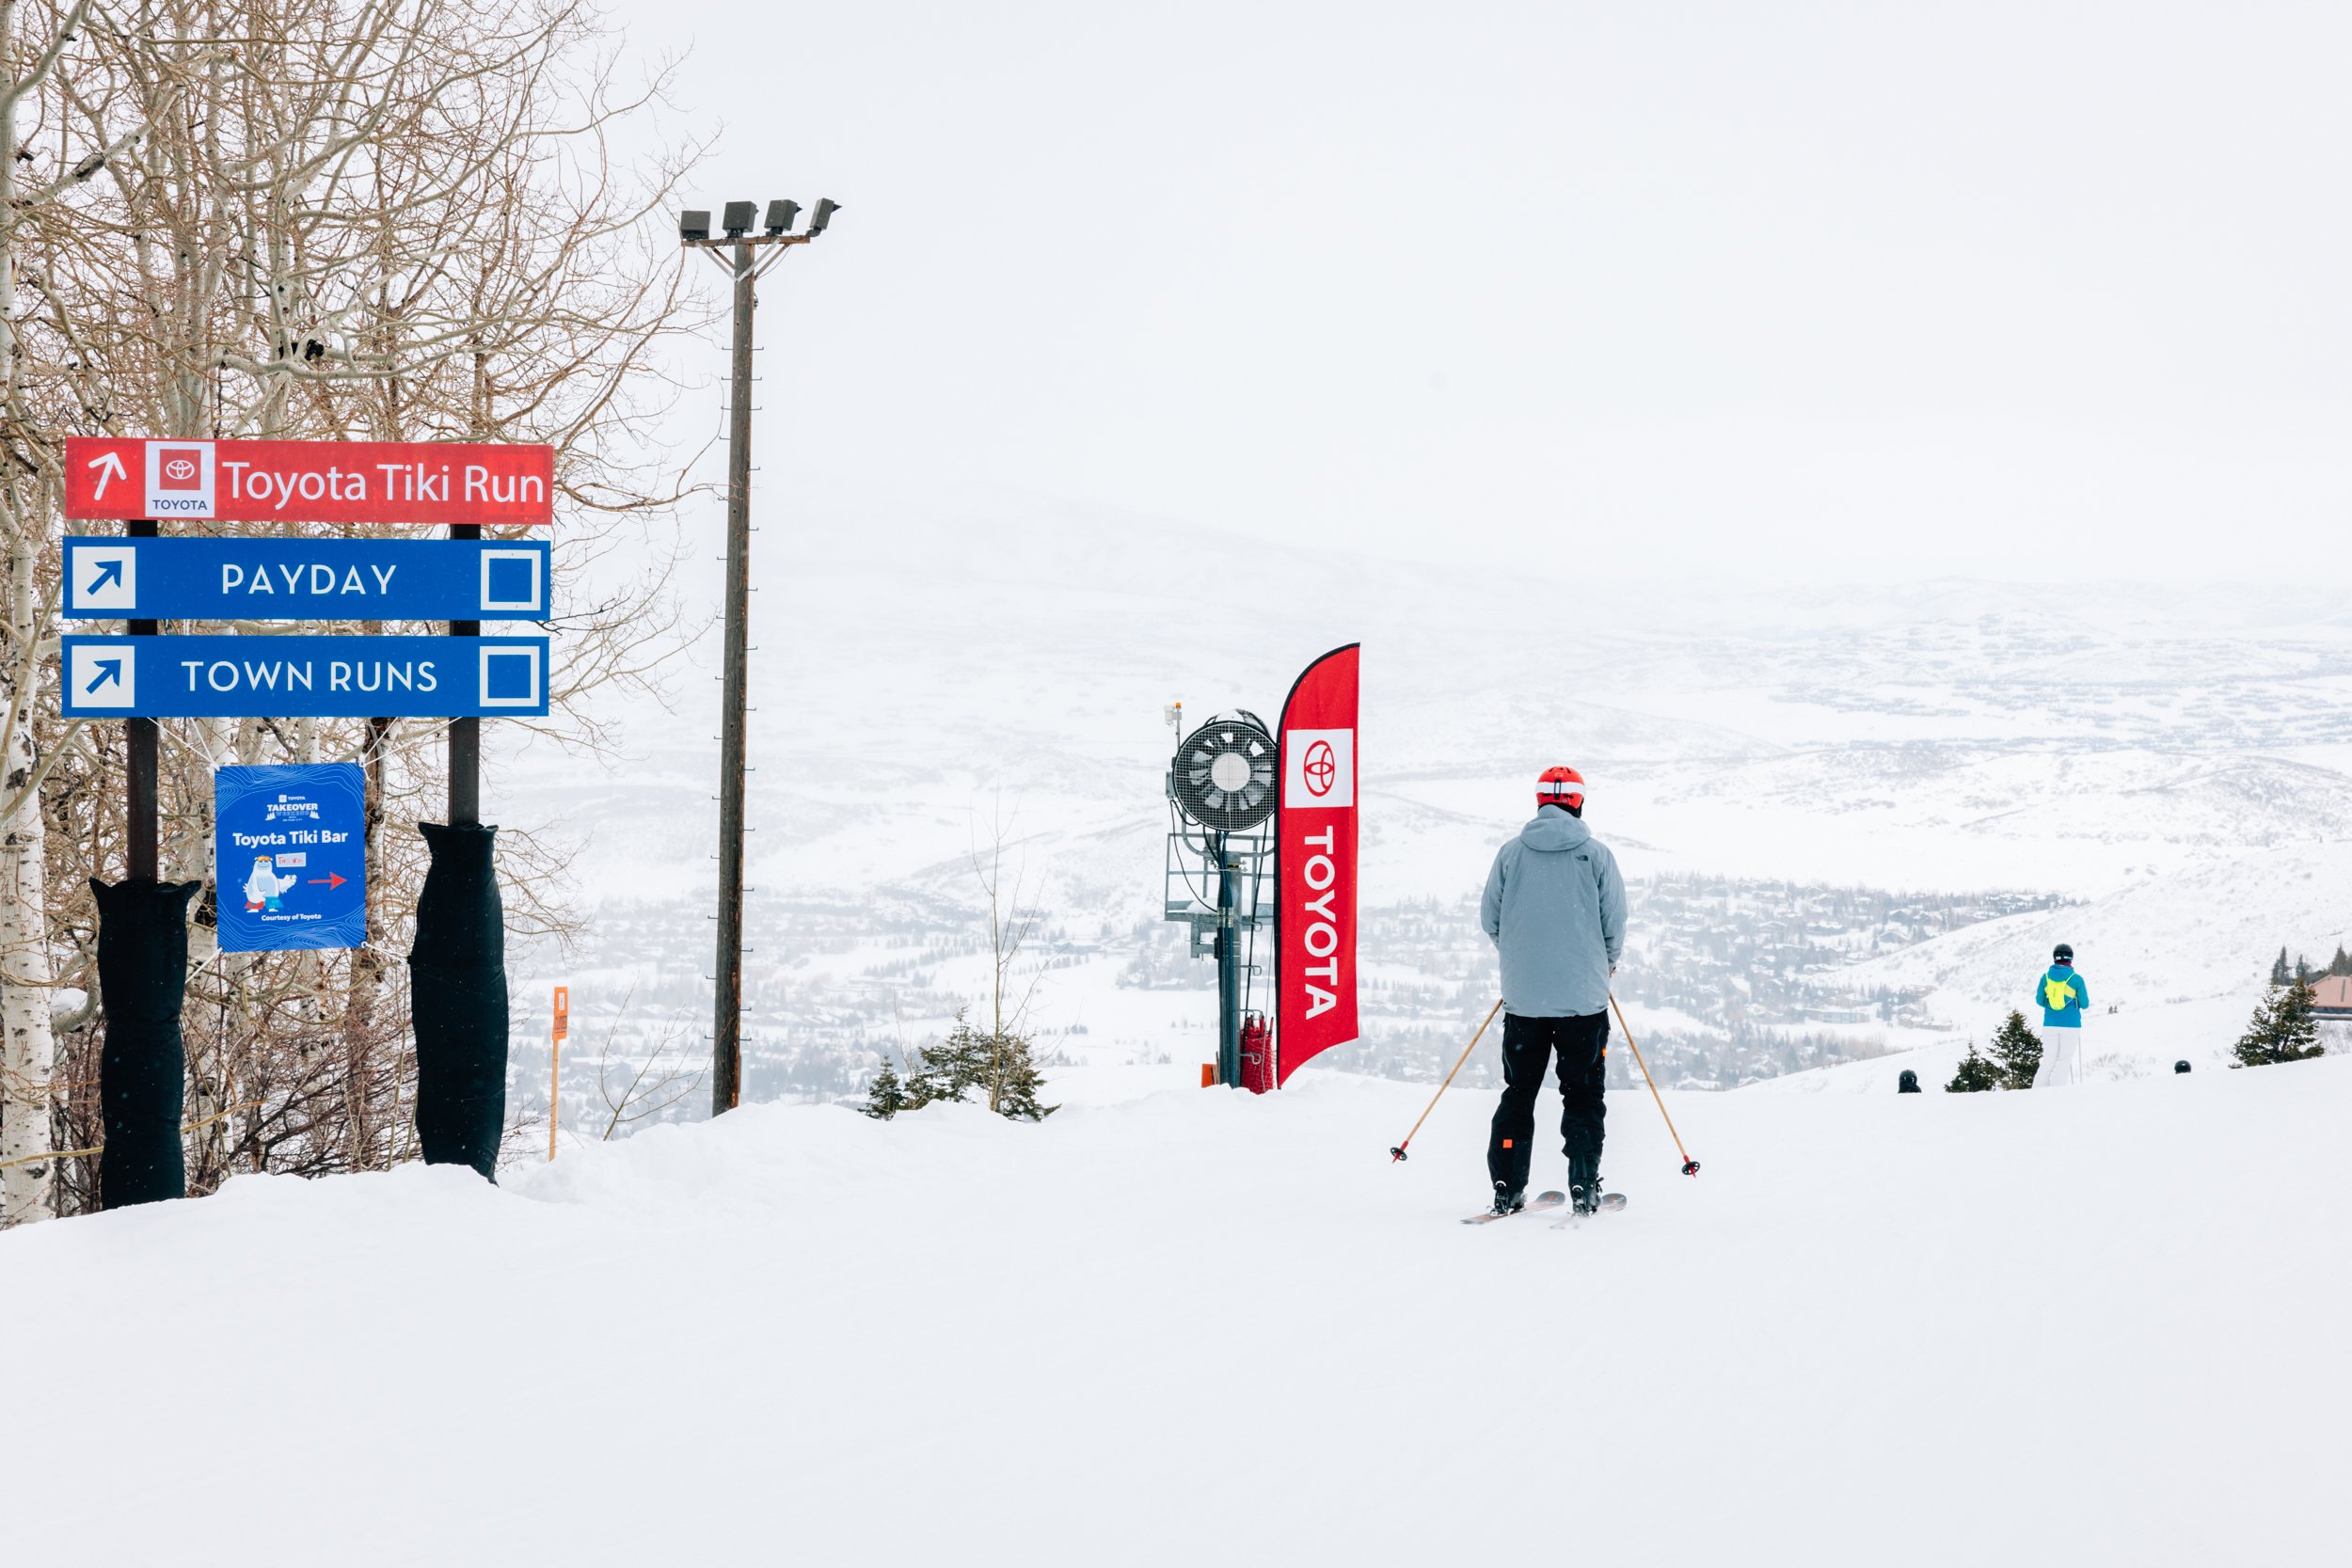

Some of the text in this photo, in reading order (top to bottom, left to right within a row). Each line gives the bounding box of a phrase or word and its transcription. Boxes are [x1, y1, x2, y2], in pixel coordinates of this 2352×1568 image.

[222, 462, 543, 510] Toyota Tiki Run
[152, 500, 207, 510] TOYOTA
[223, 564, 396, 594] PAYDAY
[182, 661, 437, 691] TOWN RUNS
[266, 802, 318, 812] TAKEOVER
[233, 830, 348, 848] Toyota Tiki Bar
[1304, 826, 1337, 1020] TOYOTA
